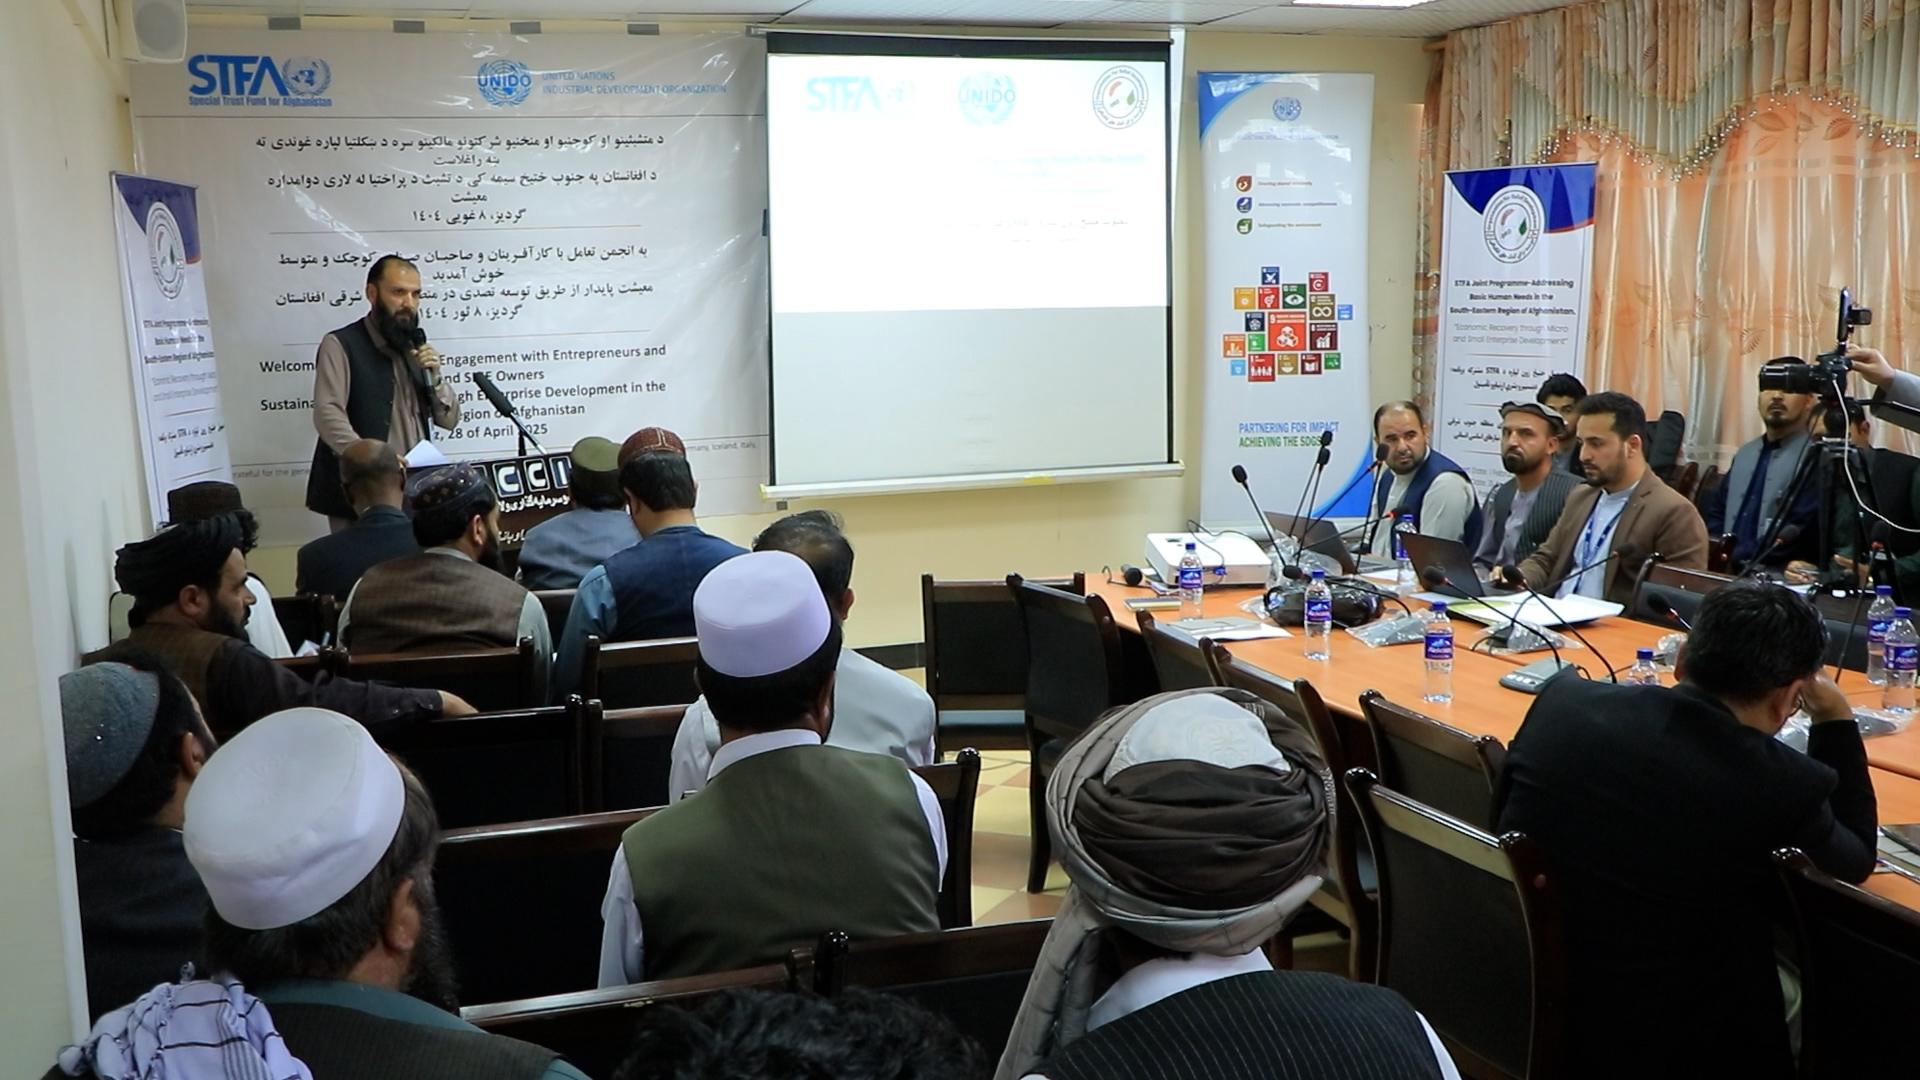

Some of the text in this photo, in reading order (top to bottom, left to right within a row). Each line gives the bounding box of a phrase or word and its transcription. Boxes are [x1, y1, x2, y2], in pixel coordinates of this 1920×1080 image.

[188, 54, 290, 96] STFA
[478, 73, 532, 88] UNIDO
[542, 72, 615, 81] UNITED NATIONS
[542, 84, 727, 95] INDUSTRIAL DEVELOPMENT ORGANIZATION
[806, 76, 882, 113] STFA
[958, 88, 1016, 104] UNIDO
[551, 172, 585, 186] جنوب
[602, 169, 647, 183] افغانستان
[477, 252, 484, 263] و
[556, 246, 564, 258] با
[567, 246, 596, 262] تعامل
[600, 245, 634, 261] انجمن
[278, 253, 318, 269] متوسط
[322, 256, 329, 268] و
[432, 266, 505, 283] خوش آمدید
[442, 290, 456, 302] در
[500, 286, 531, 301] توسعه
[535, 284, 566, 300] طریق
[570, 284, 579, 298] از
[583, 282, 613, 298] پایدار
[275, 291, 325, 307] افغانستان
[259, 344, 666, 373] Welcom Engagement with Entrepreneurs and
[443, 370, 545, 384] nd SE Owners
[260, 399, 315, 411] Sustaina
[545, 384, 628, 402] Development
[630, 383, 643, 395] in
[645, 381, 666, 393] the
[448, 427, 463, 439] 28
[466, 426, 480, 438] of
[483, 425, 514, 441] April
[525, 423, 548, 436] 025
[1239, 421, 1340, 434] PARTNERING FOR IMPACT
[1239, 436, 1281, 448] ACHIEVING
[1283, 435, 1298, 447] THE
